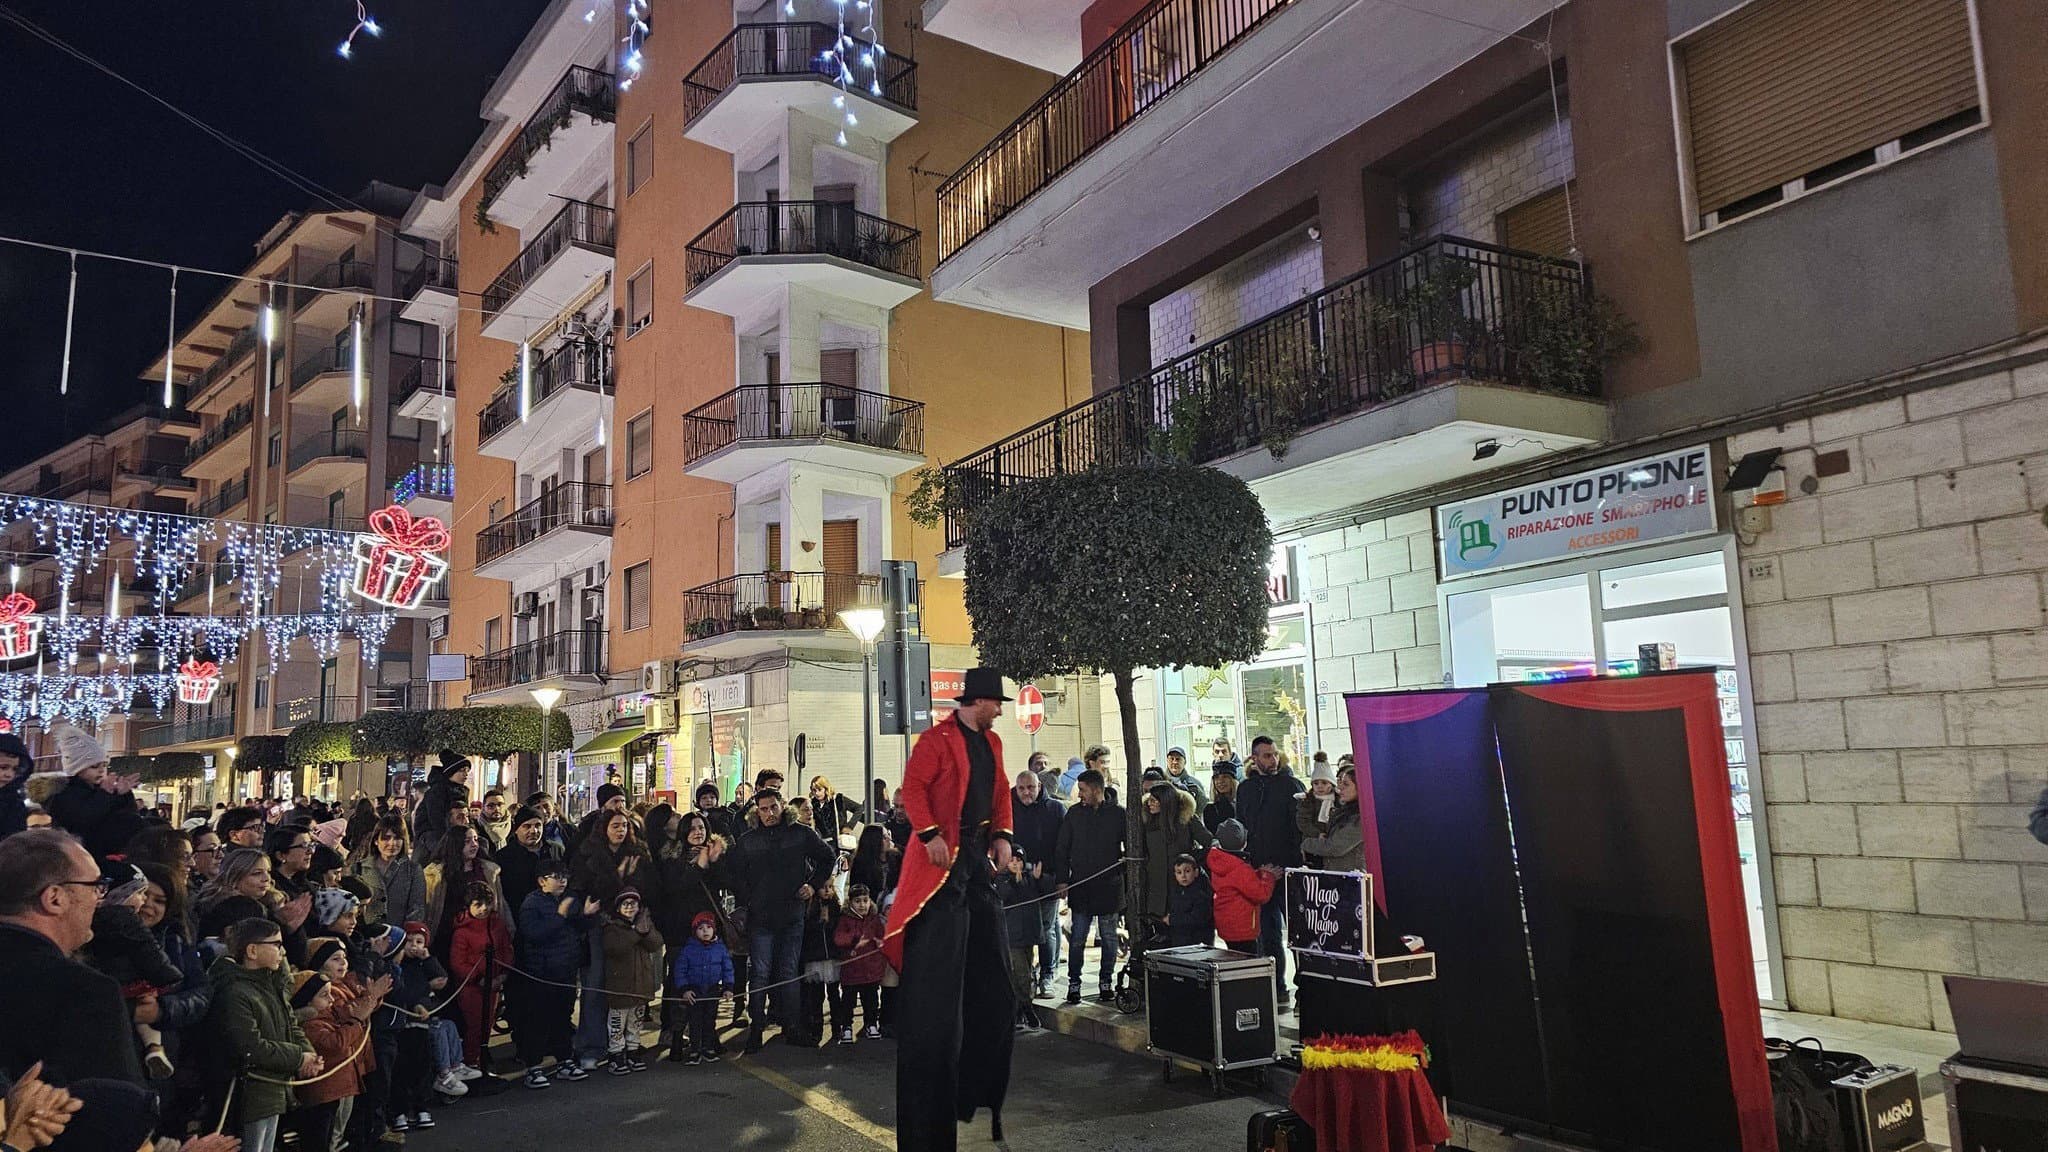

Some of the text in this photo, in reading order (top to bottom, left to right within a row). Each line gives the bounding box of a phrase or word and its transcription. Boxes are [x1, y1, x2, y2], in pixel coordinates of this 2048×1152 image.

[1501, 452, 1705, 519] PUNTO PHONE
[1507, 511, 1594, 540] RIPARAZIONE
[1568, 526, 1640, 550] ACCESSORI
[932, 681, 950, 692] gas
[951, 682, 959, 690] e
[1303, 875, 1339, 920] Mago
[1305, 908, 1339, 945] Magno
